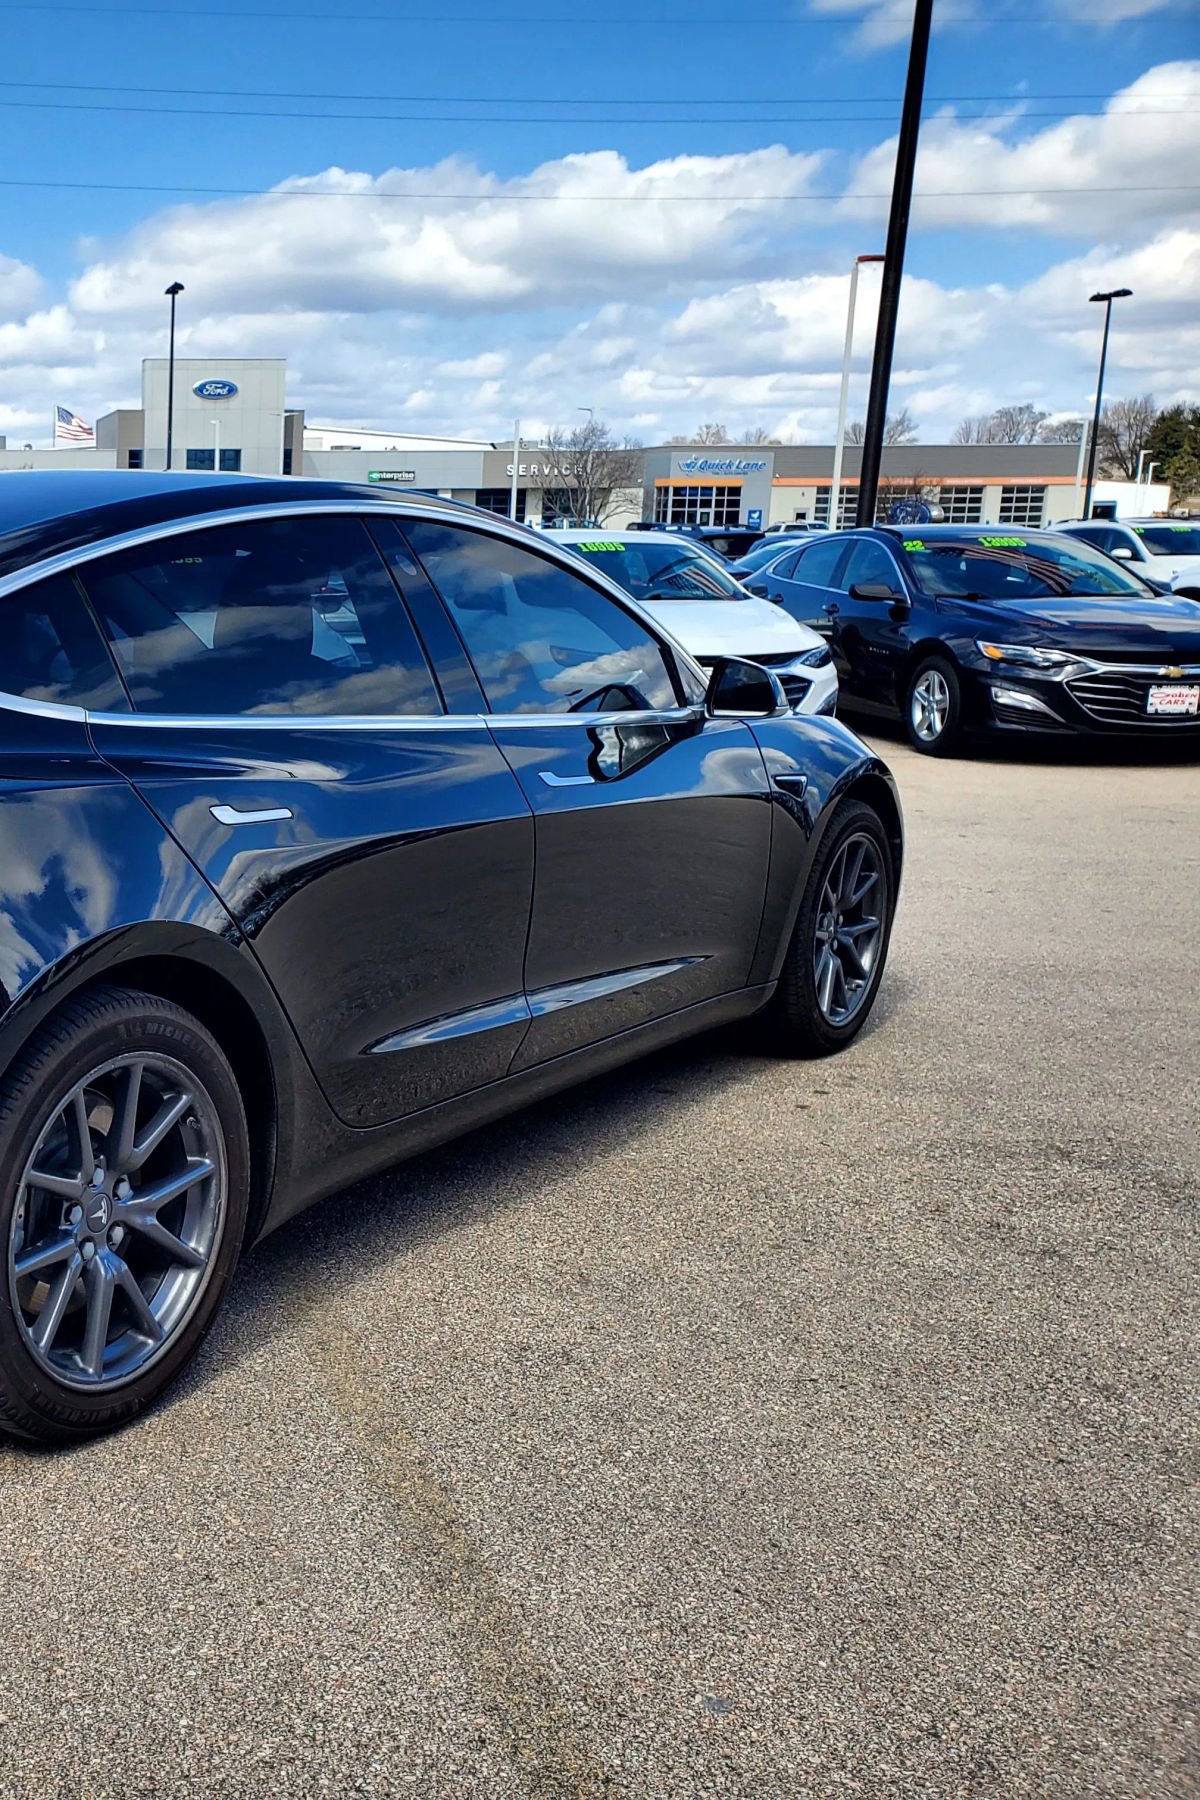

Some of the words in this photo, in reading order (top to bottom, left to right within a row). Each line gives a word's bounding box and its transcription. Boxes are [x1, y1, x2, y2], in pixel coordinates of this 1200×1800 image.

[506, 464, 584, 476] SERVICE
[698, 459, 735, 472] Quick
[736, 459, 767, 472] Lane
[370, 472, 415, 480] enterprise
